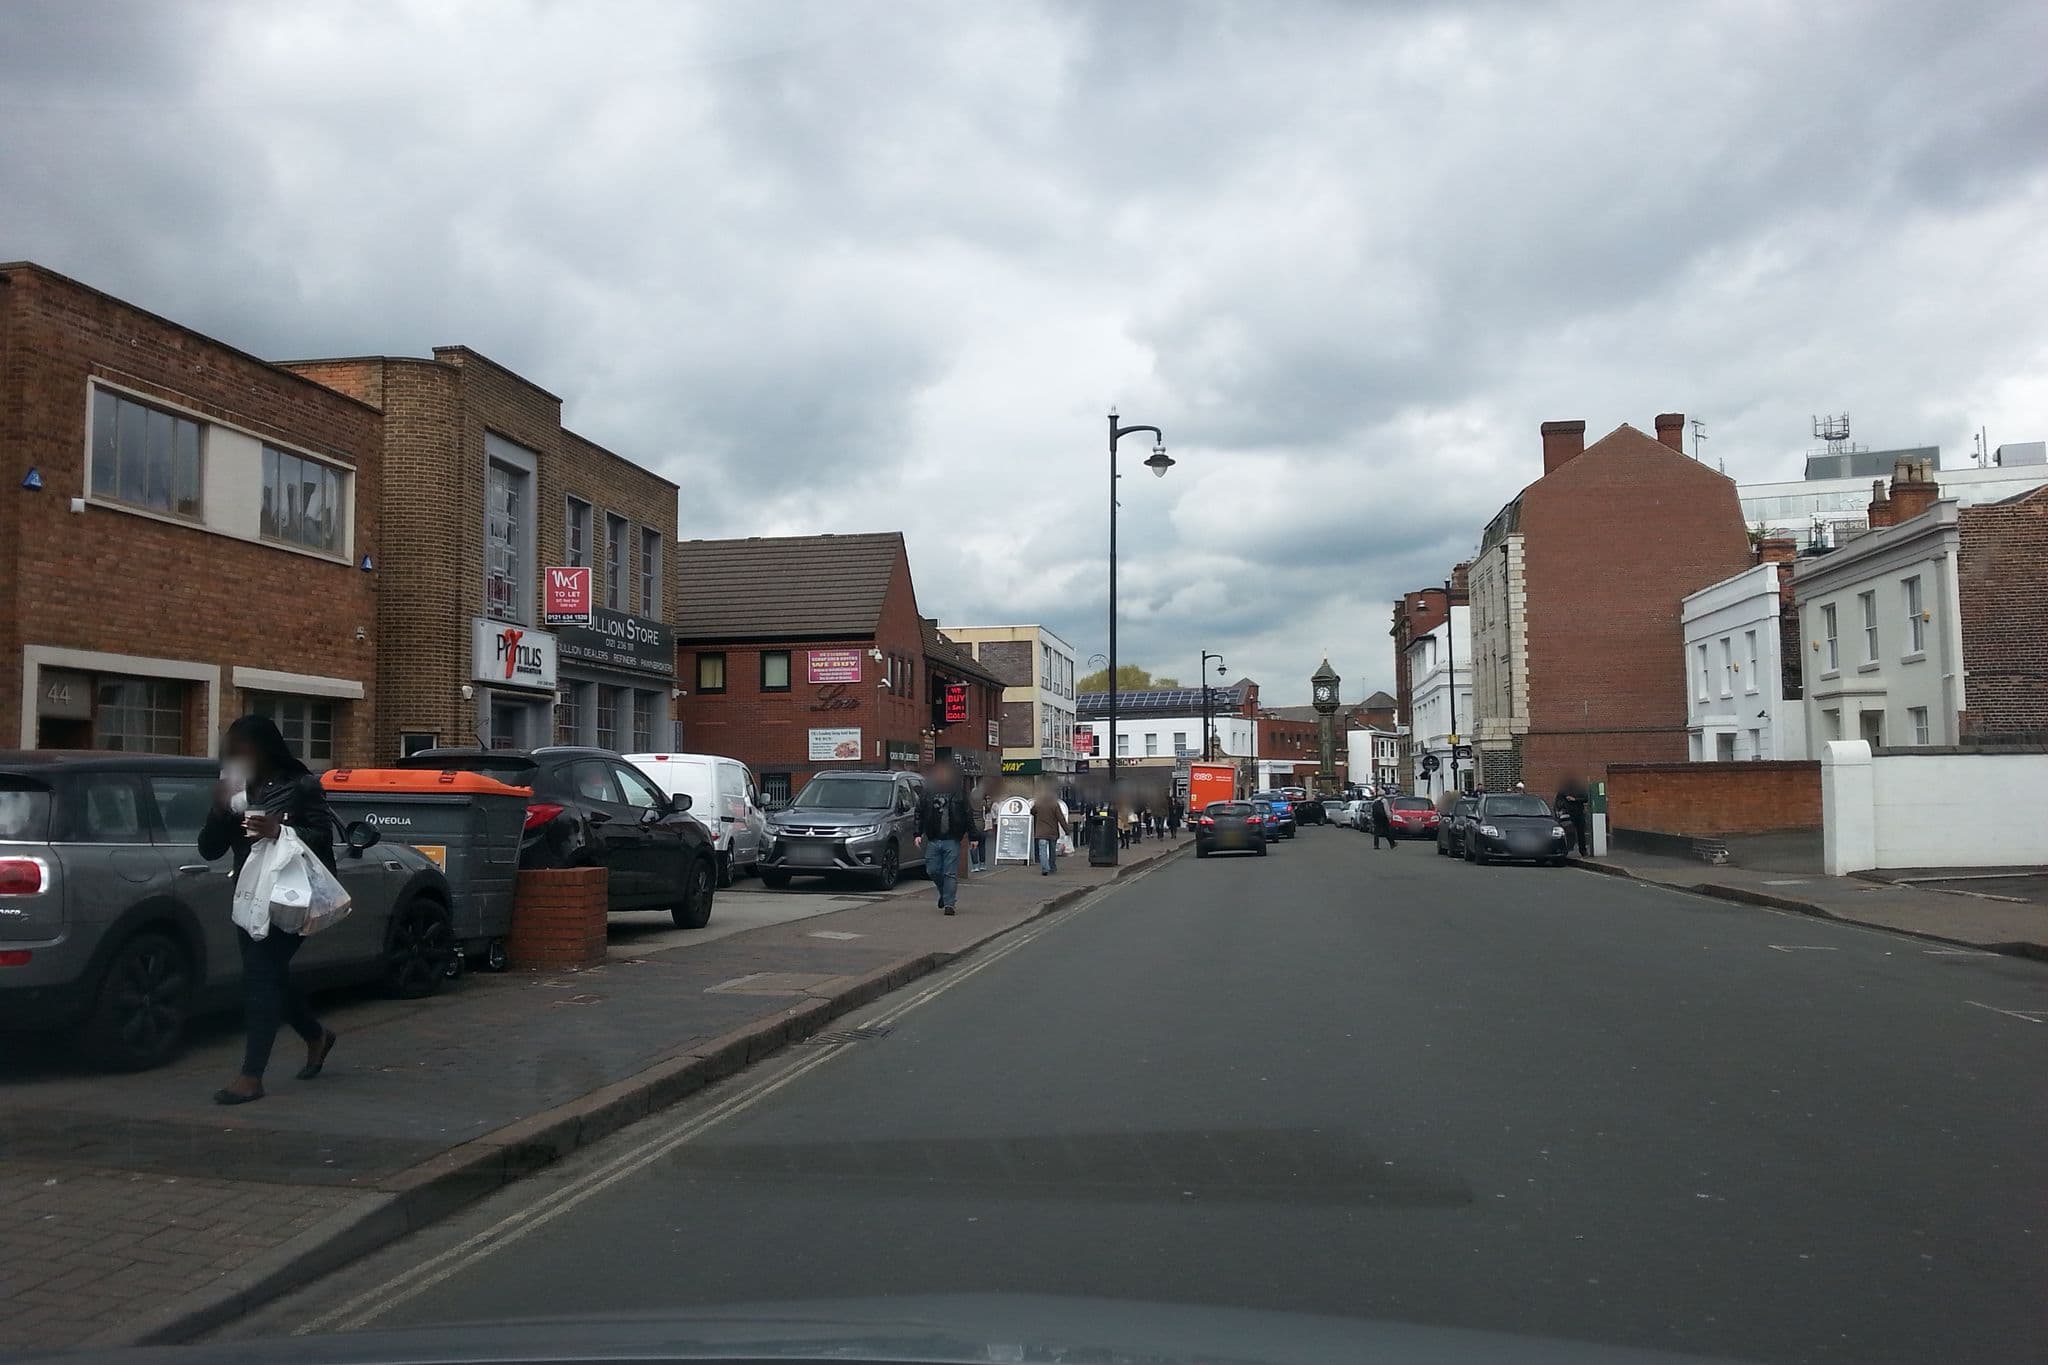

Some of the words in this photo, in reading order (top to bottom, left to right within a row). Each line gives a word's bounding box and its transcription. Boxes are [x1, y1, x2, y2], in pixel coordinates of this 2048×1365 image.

[1850, 520, 1866, 529] PEG
[626, 618, 660, 646] STORE
[583, 647, 608, 661] DEALERS
[47, 680, 73, 705] 44
[378, 816, 411, 825] VEOLIA
